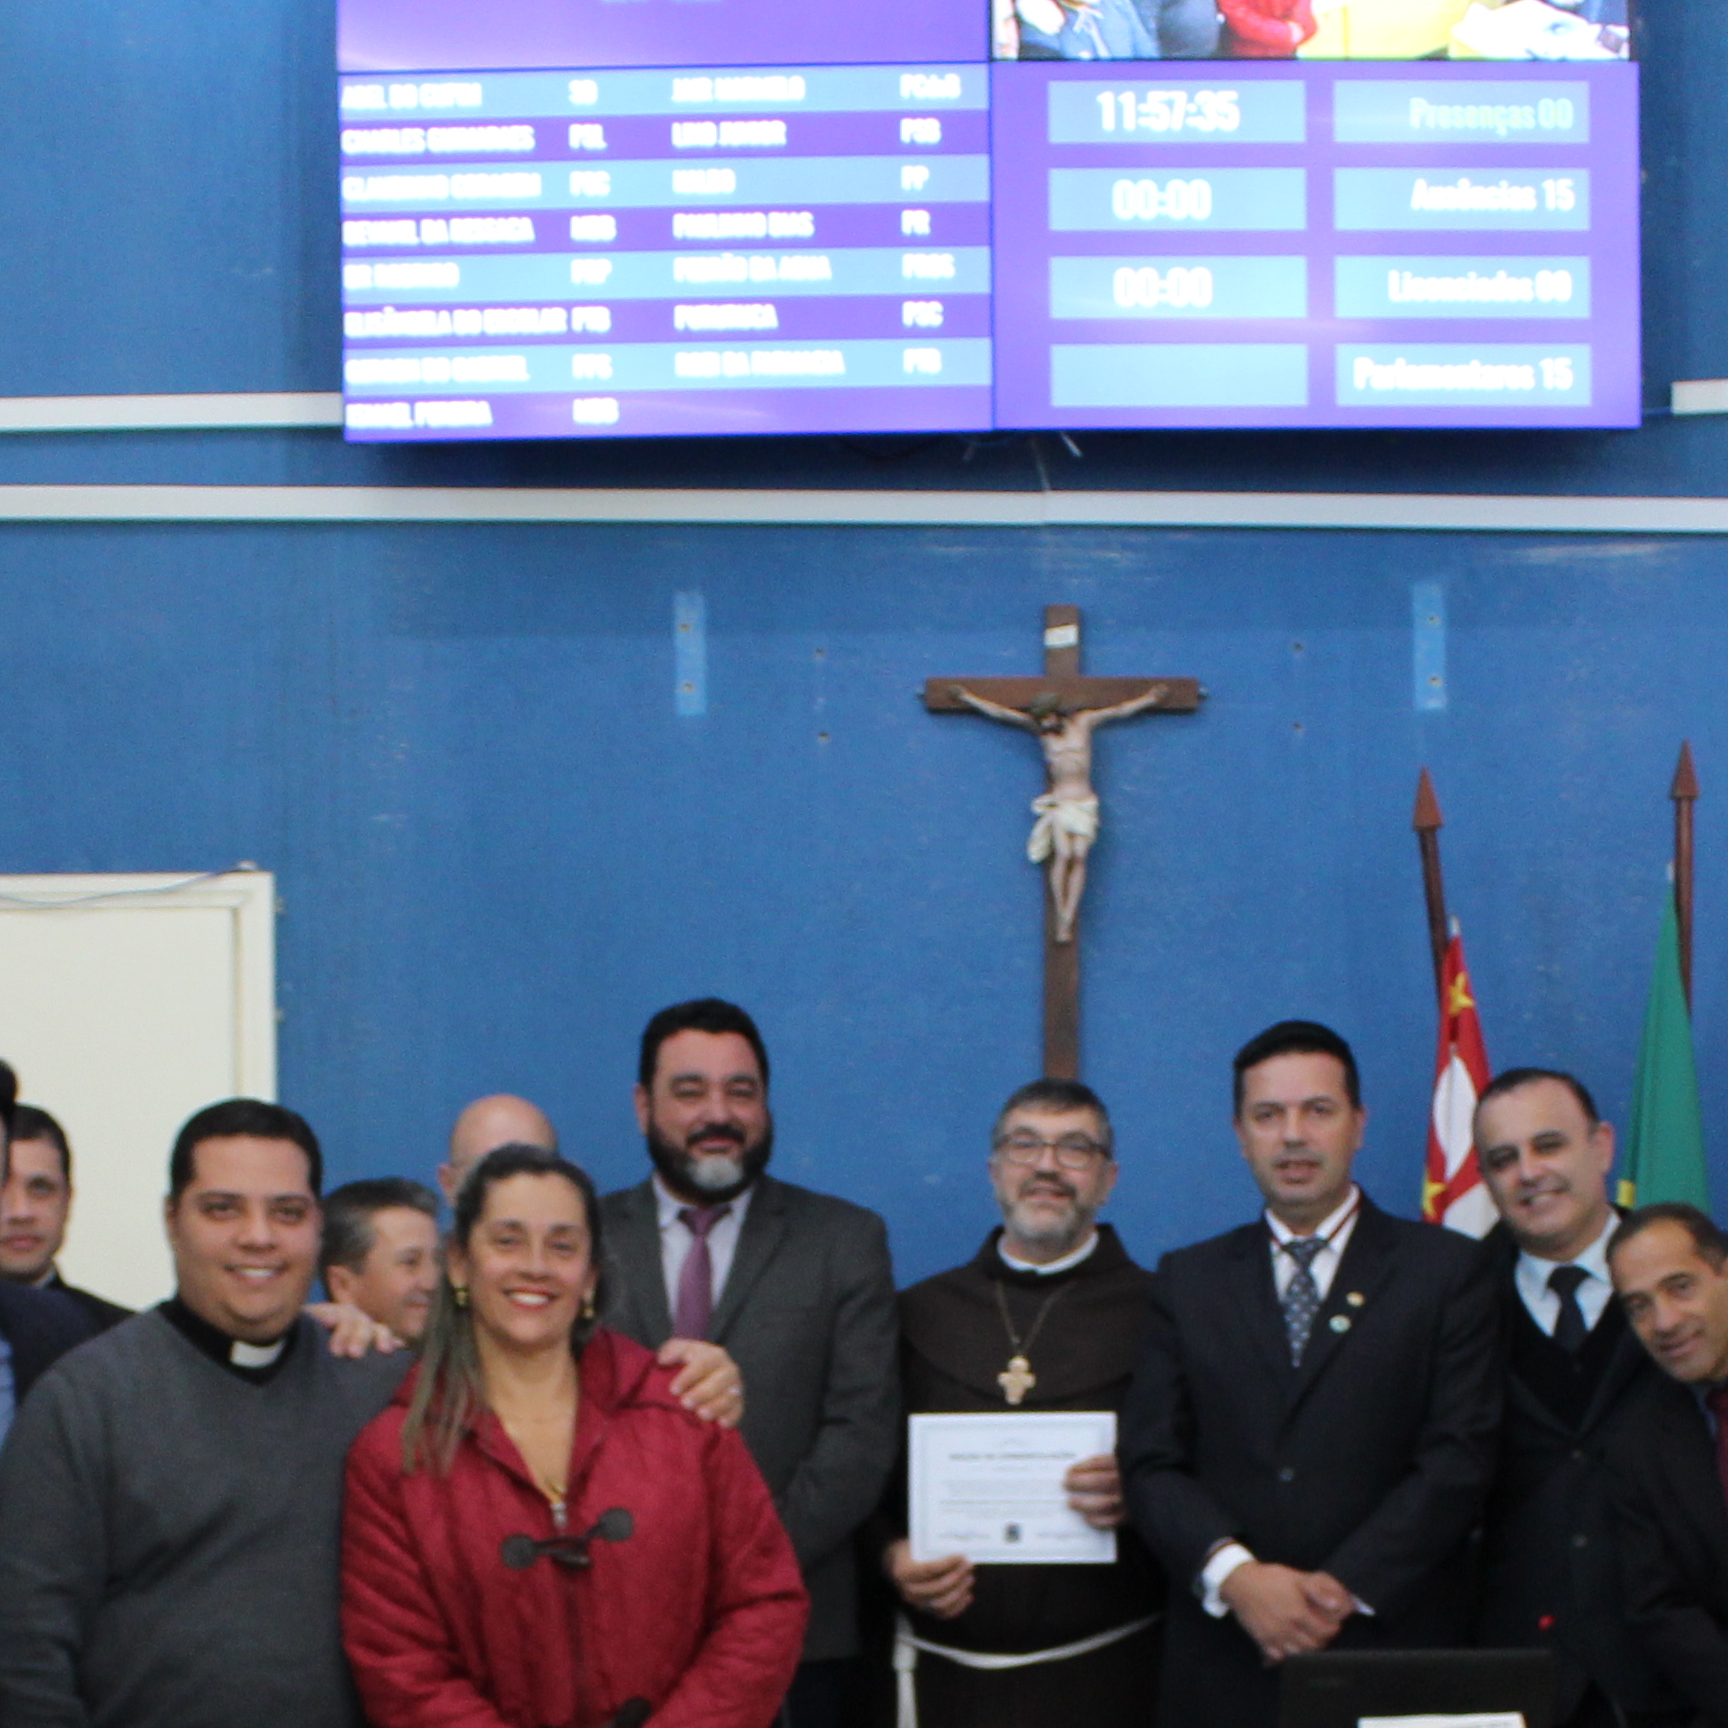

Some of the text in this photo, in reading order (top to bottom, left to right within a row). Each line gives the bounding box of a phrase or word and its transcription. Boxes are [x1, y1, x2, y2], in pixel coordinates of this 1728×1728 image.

[1098, 90, 1240, 131] 11:57:35
[1410, 98, 1573, 136] Presenças 00
[1114, 180, 1211, 219] 00:00
[1411, 178, 1575, 210] Ausências 15
[1114, 267, 1213, 307] 00:00
[1534, 270, 1572, 301] 00
[1540, 357, 1573, 389] 15
